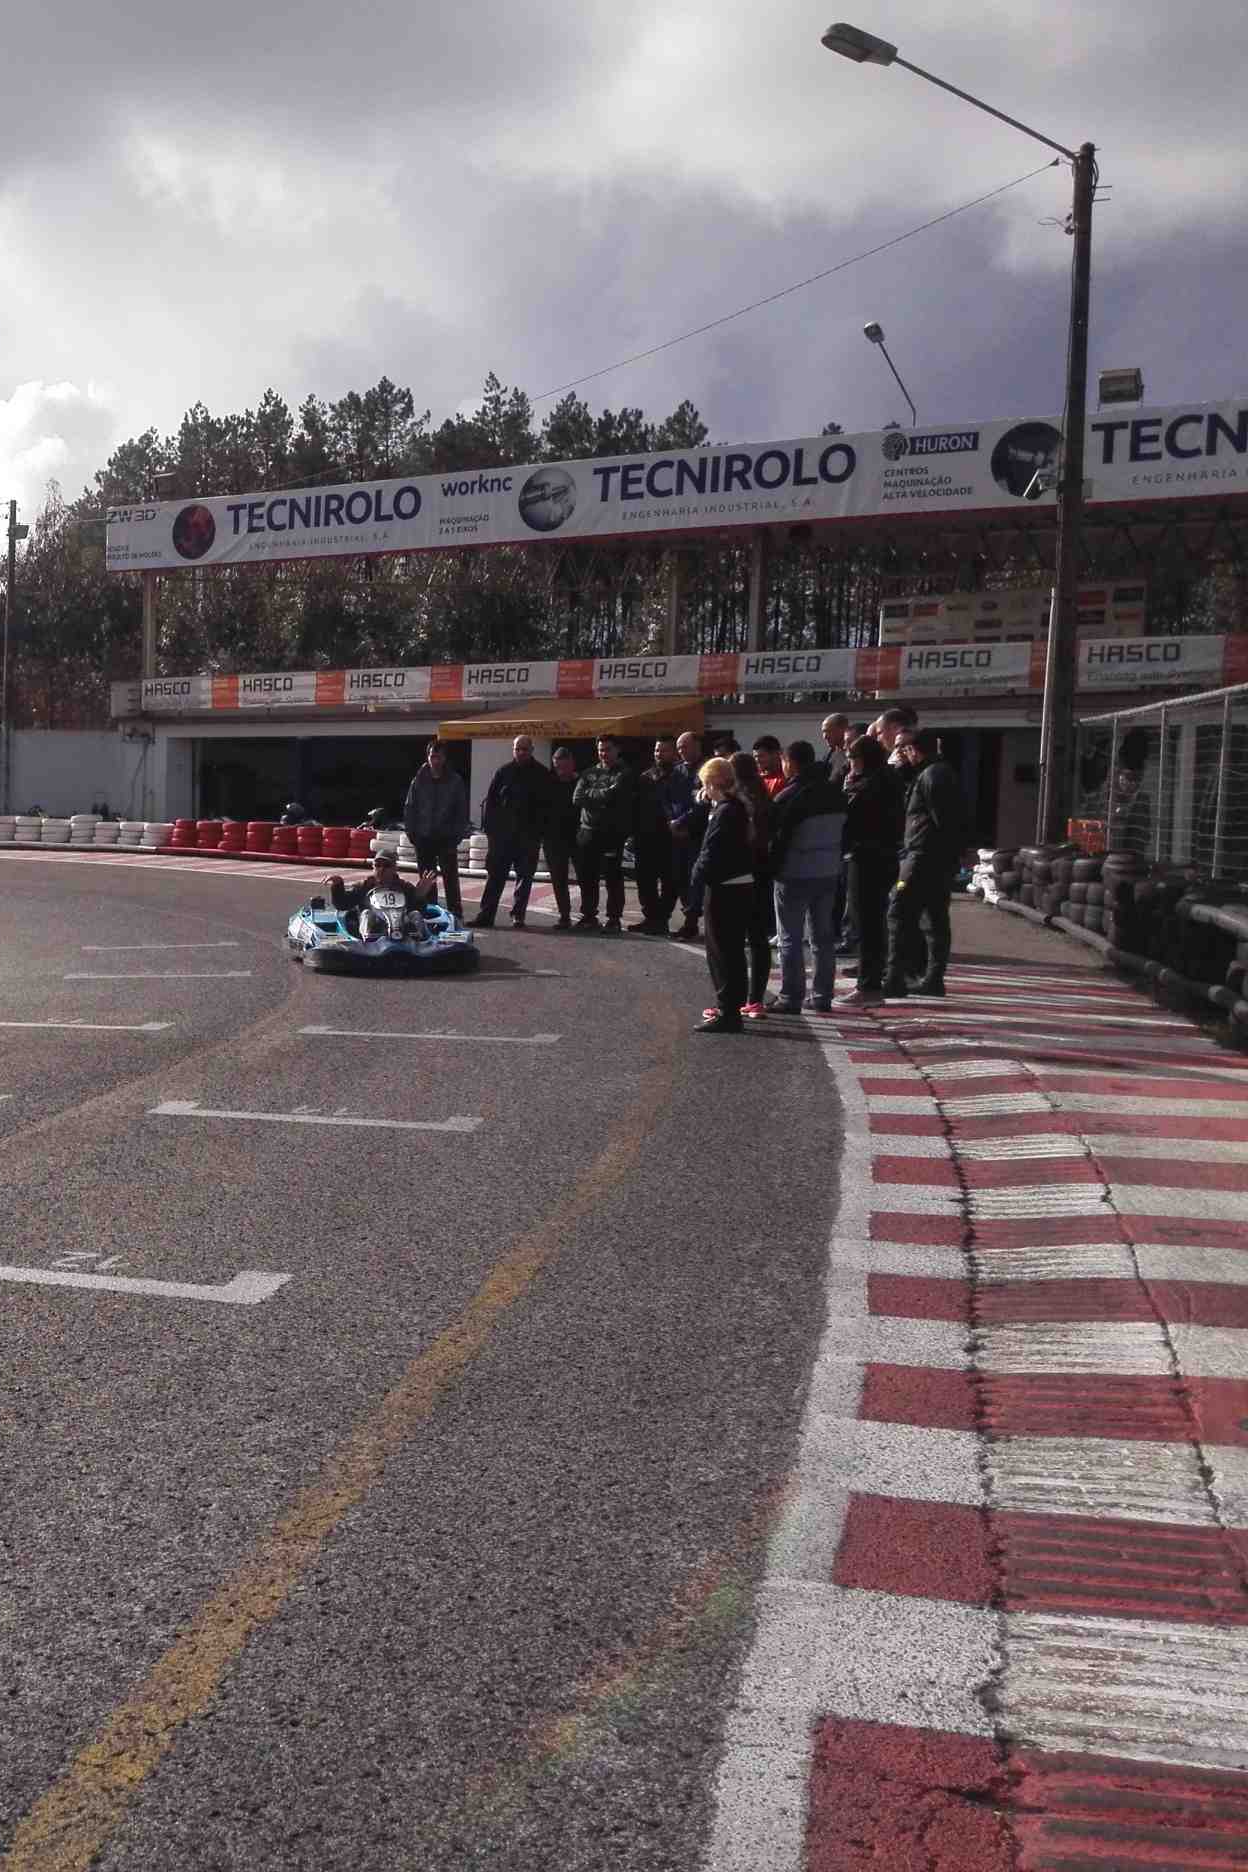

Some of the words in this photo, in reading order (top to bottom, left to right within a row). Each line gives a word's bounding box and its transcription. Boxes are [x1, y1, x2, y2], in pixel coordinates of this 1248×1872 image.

[914, 434, 974, 453] HURON
[593, 443, 857, 502] TECNIROLO
[883, 466, 929, 478] CENTROS
[1132, 469, 1238, 486] ENGENHARIA
[440, 473, 513, 497] worknc
[882, 475, 952, 488] MAQUINAÇÃO
[882, 490, 909, 500] ALTA
[910, 486, 974, 498] VELOCIDADE
[106, 508, 157, 524] ZW3D
[226, 485, 422, 535] TECNIROLO
[622, 506, 699, 521] ENGENHARIA
[907, 650, 992, 669] HASCO
[1087, 643, 1181, 664] HASCO
[599, 662, 668, 680] HASCO
[744, 655, 821, 674] HASCO
[349, 672, 405, 689] HASCO
[467, 667, 529, 685] HASCO
[144, 681, 191, 697] HASCO
[242, 677, 293, 694] HASCO
[382, 892, 396, 905] 19
